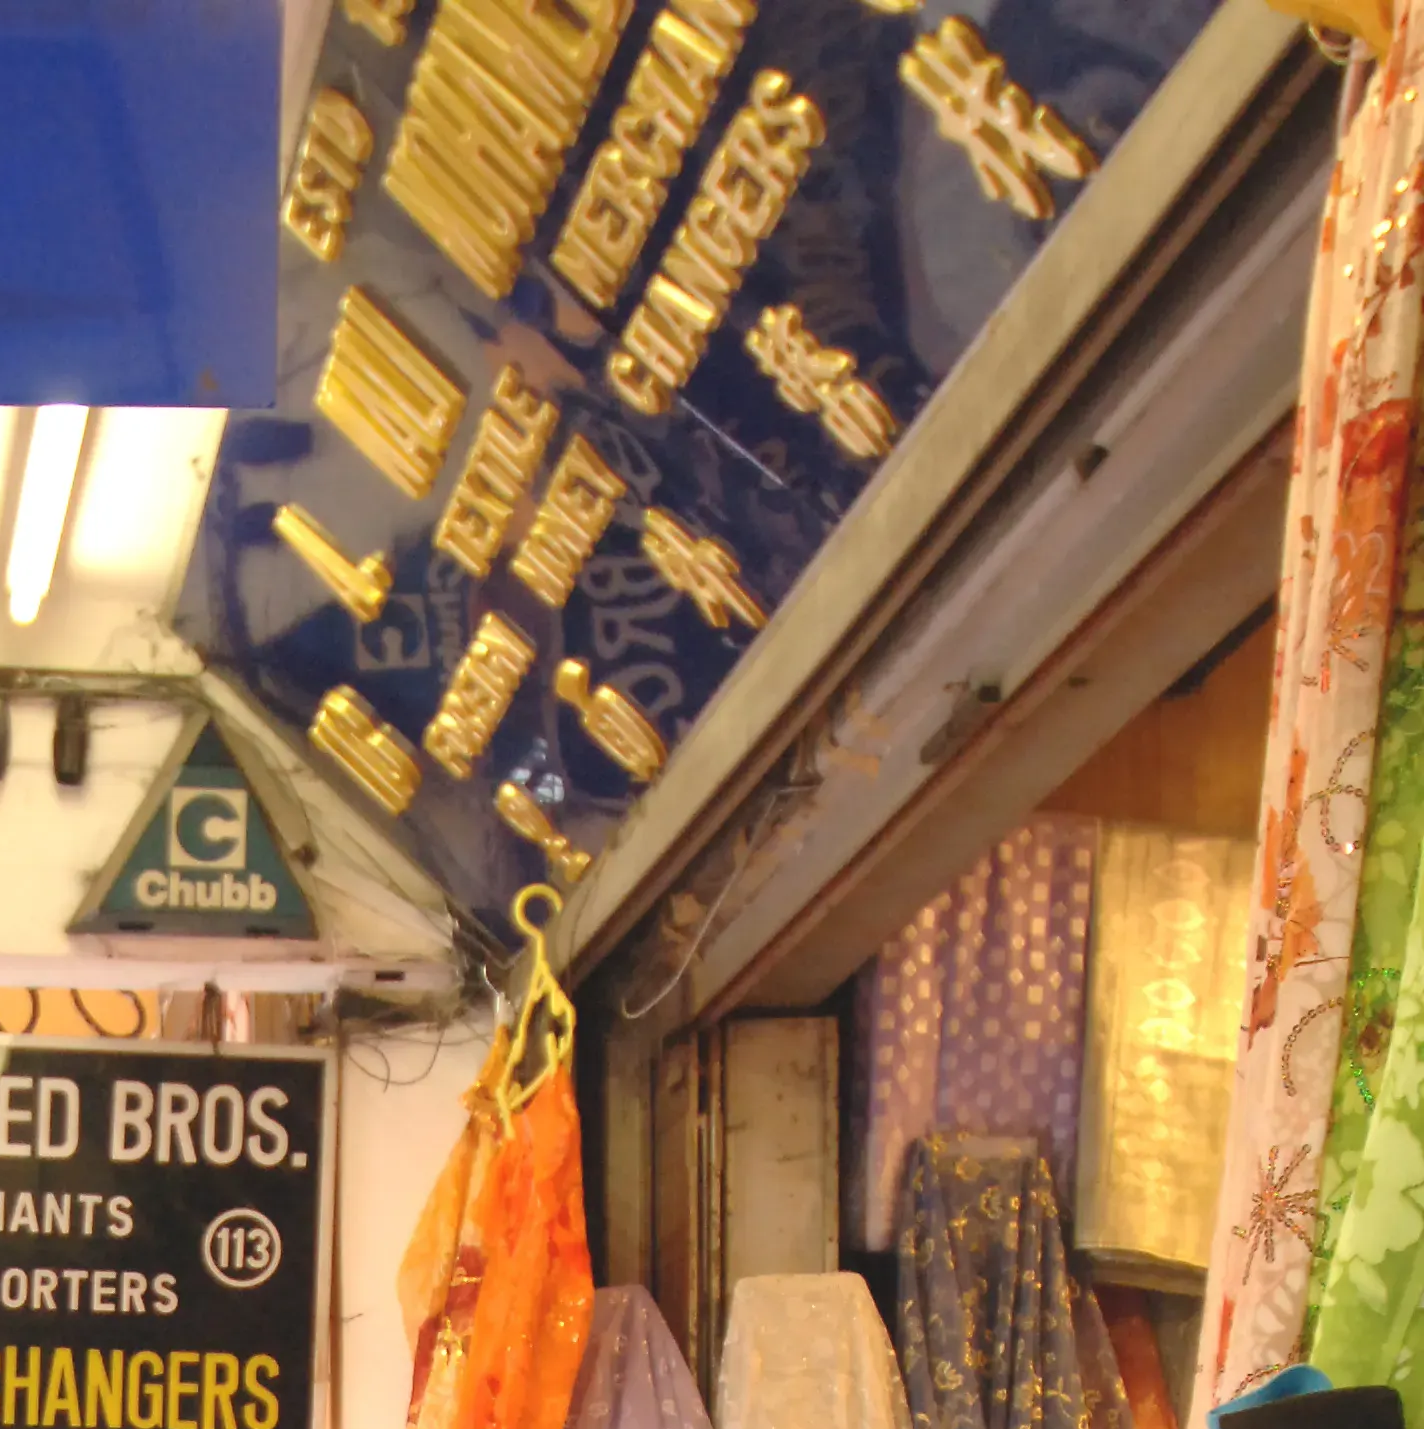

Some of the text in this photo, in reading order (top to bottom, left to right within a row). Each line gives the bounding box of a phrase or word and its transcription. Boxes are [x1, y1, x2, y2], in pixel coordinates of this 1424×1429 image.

[381, 0, 637, 301] MOHAM
[422, 69, 826, 780] FOREIGN MONEY CHANGERS
[434, 363, 559, 578] TEXTILE
[135, 868, 277, 911] Chubb
[110, 1078, 309, 1170] BROS.
[214, 1227, 270, 1270] 113
